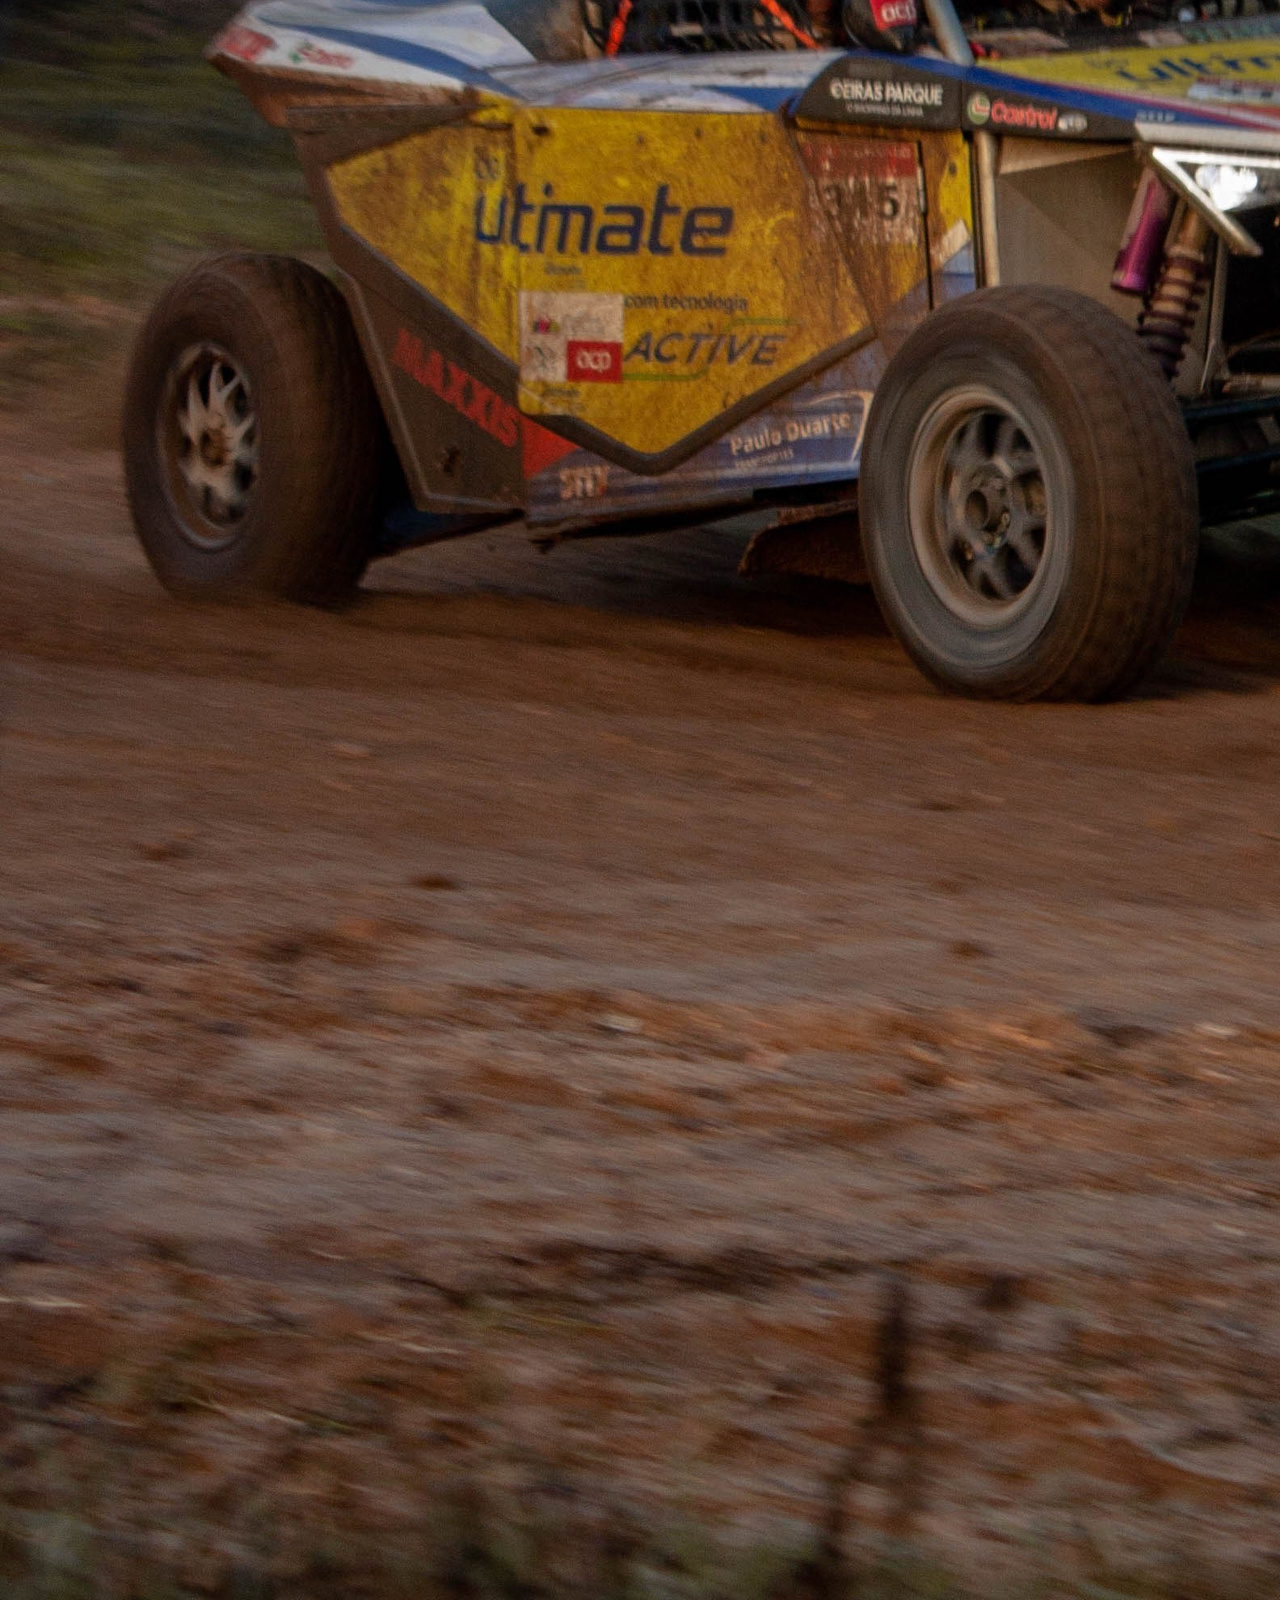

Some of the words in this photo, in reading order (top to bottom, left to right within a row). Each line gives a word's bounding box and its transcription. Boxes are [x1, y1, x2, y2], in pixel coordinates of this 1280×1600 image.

[885, 81, 943, 106] PARQUE
[623, 330, 788, 366] ACTIVE
[730, 427, 782, 457] Paulo
[785, 410, 852, 442] Duarte
